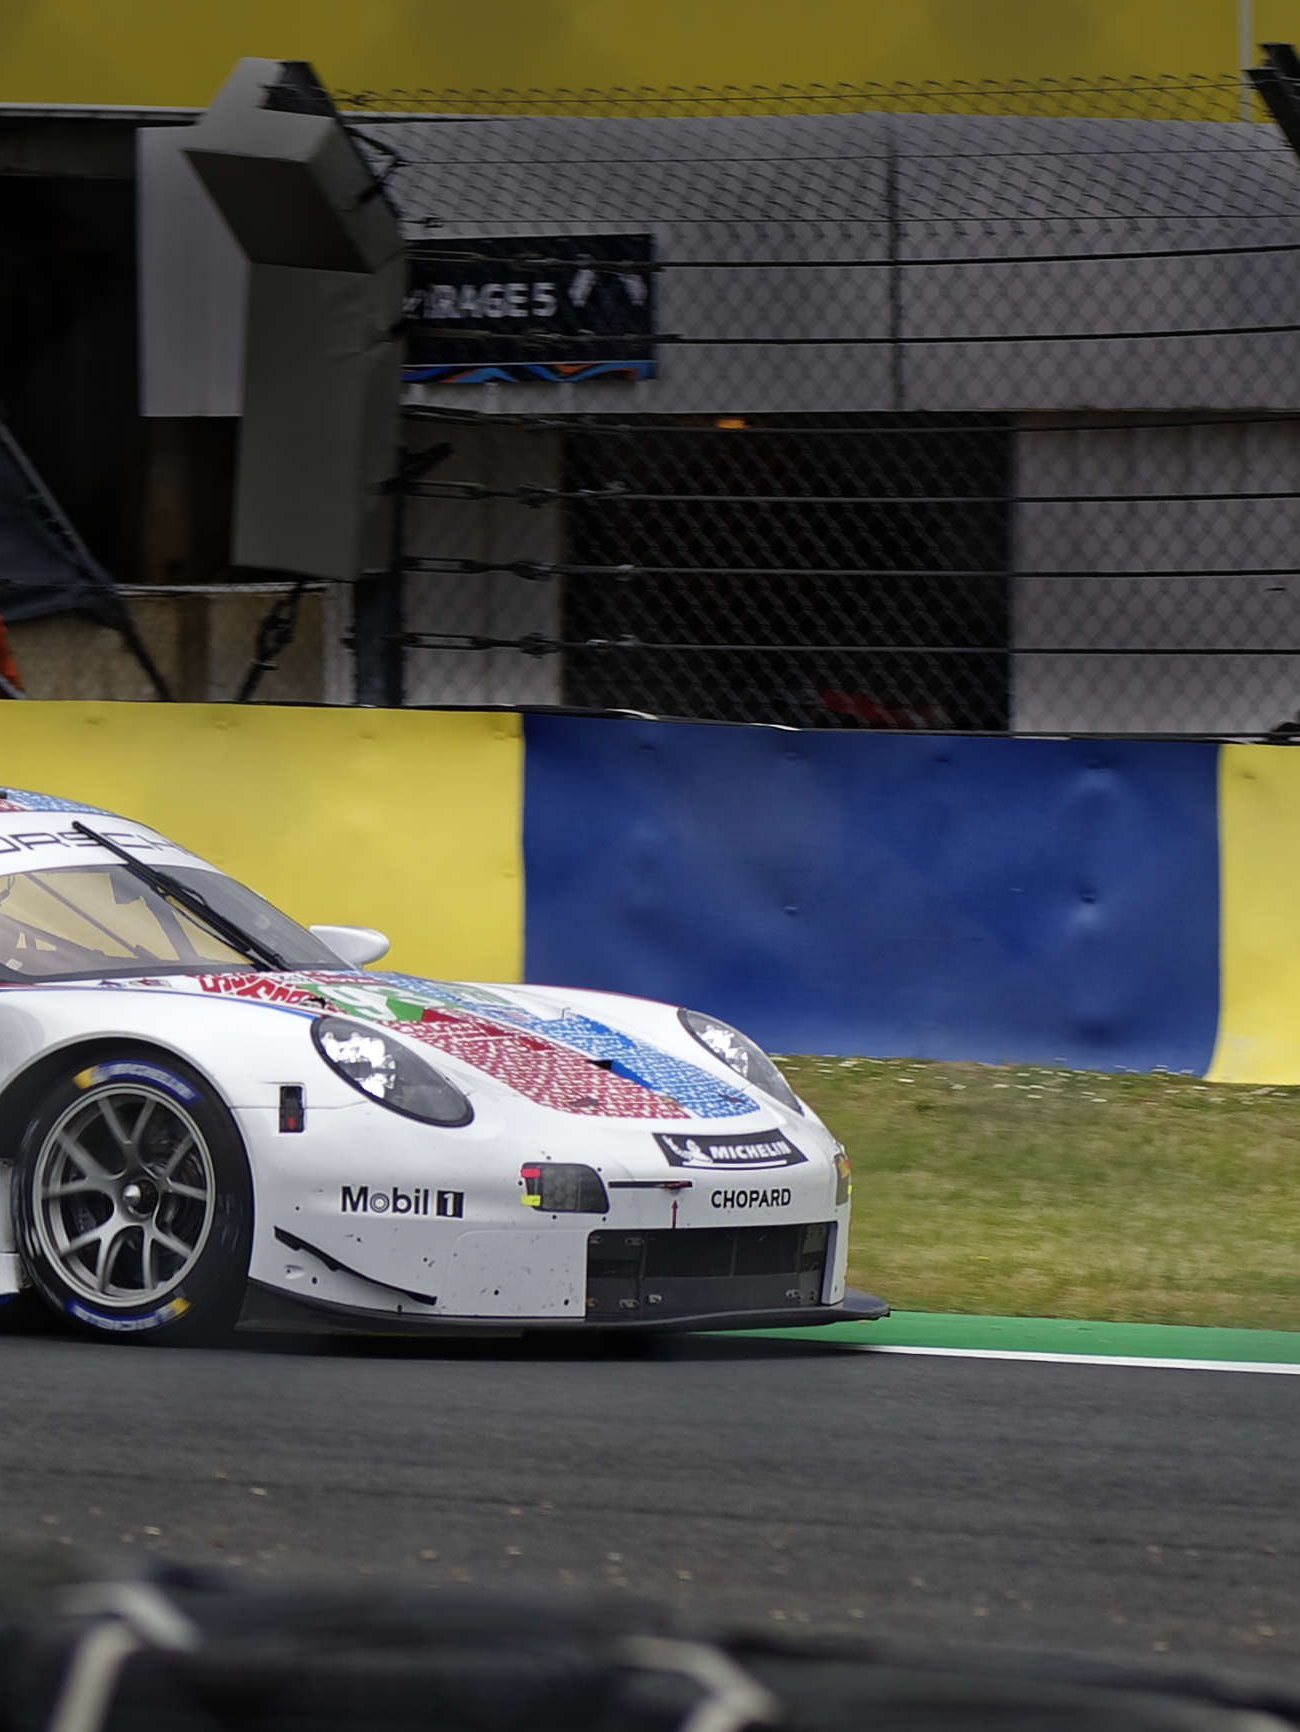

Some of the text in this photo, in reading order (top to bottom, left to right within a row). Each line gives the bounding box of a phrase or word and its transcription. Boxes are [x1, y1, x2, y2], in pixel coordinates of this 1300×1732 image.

[709, 1141, 791, 1160] MICHELIN
[341, 1186, 429, 1215] Mobil
[711, 1188, 792, 1209] CHOPARD
